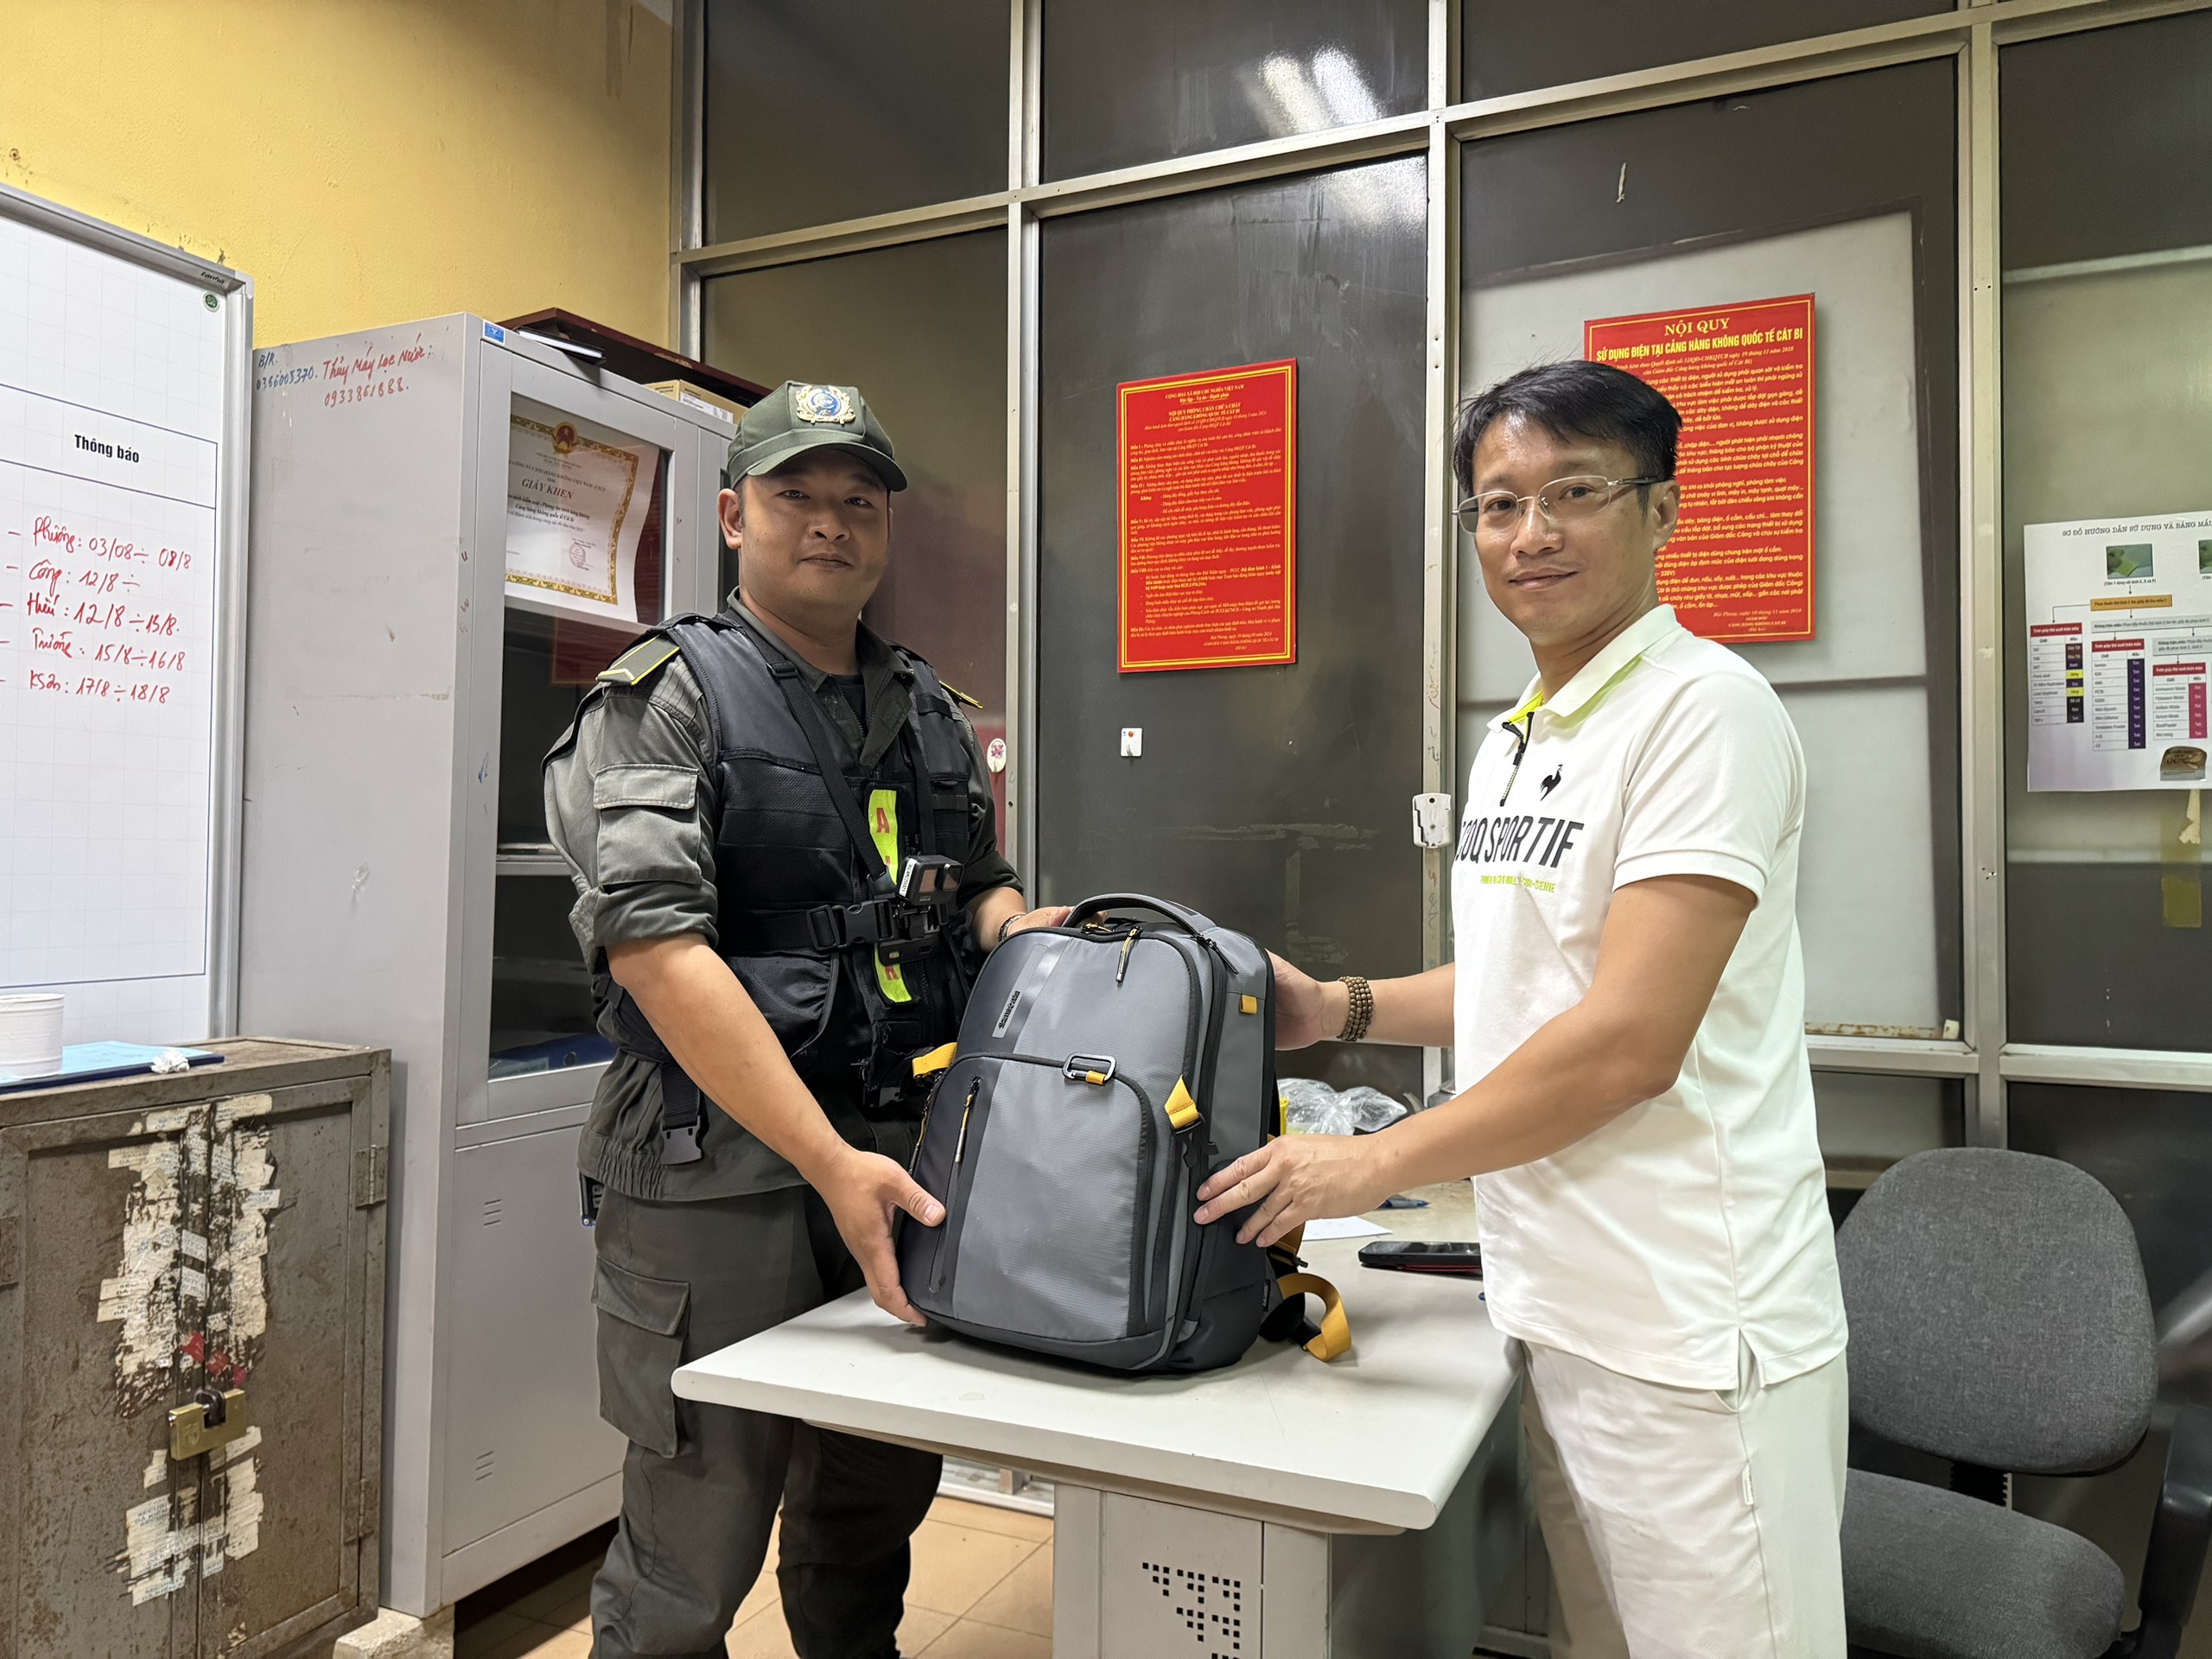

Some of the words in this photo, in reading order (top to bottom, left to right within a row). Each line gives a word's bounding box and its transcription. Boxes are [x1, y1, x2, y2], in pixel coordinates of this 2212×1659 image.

[1665, 320, 1692, 336] NỘI
[1696, 318, 1729, 333] QUY
[1596, 346, 1607, 361] SỬ
[1608, 347, 1630, 361] DỤNG
[1630, 344, 1649, 359] ĐIỆN
[1650, 343, 1663, 357] TẠI
[1664, 339, 1687, 353] CẢNG
[1688, 338, 1710, 351] HÀNG
[1712, 334, 1738, 348] KHÔNG
[1741, 329, 1763, 346] QUỐC
[1764, 327, 1774, 342] TẾ
[1776, 327, 1792, 340] CÁT
[1794, 327, 1802, 339] BI
[74, 434, 112, 458] Thông
[117, 445, 140, 463] báo
[1484, 815, 1585, 868] SPORTIF
